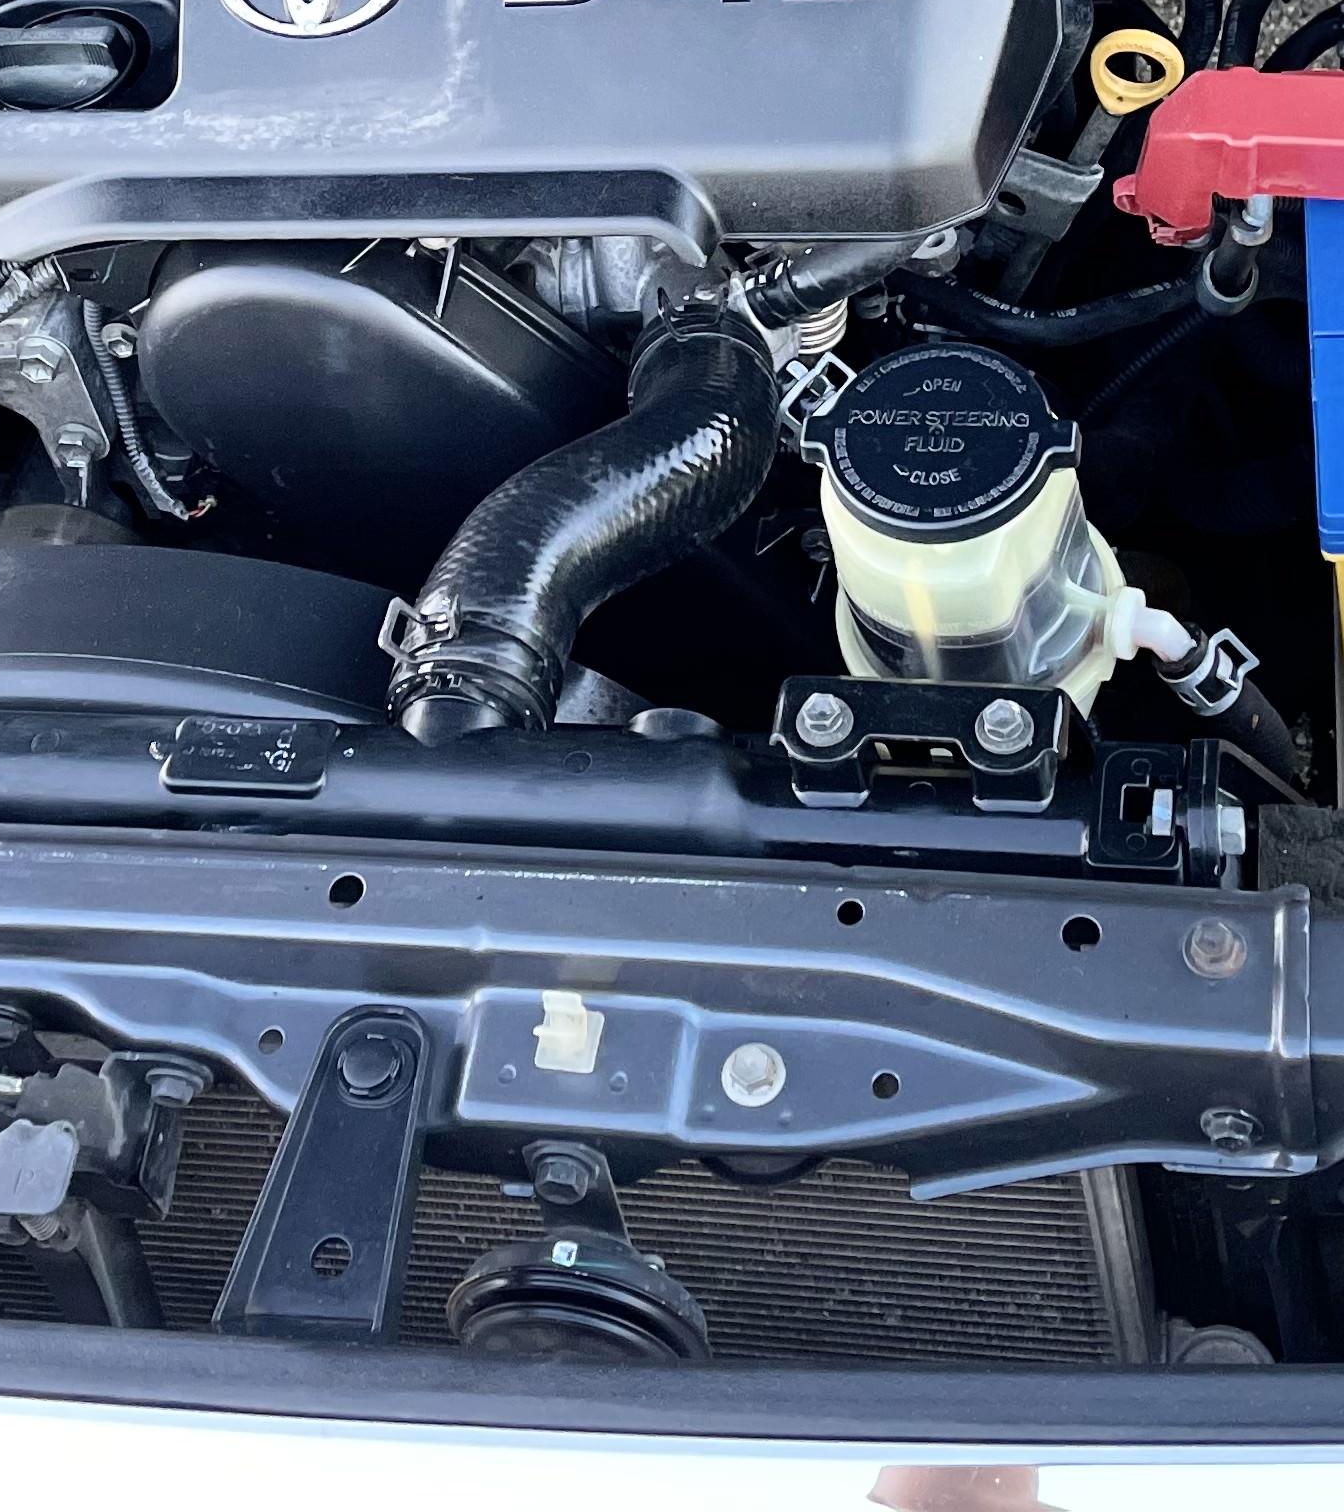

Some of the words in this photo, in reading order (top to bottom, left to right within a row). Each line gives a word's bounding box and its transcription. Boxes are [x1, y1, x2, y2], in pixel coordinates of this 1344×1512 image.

[922, 378, 962, 393] OPEN
[847, 409, 922, 425] POWER
[925, 410, 1030, 428] STEERING
[904, 436, 965, 453] FLUID
[909, 468, 962, 485] CLOSE
